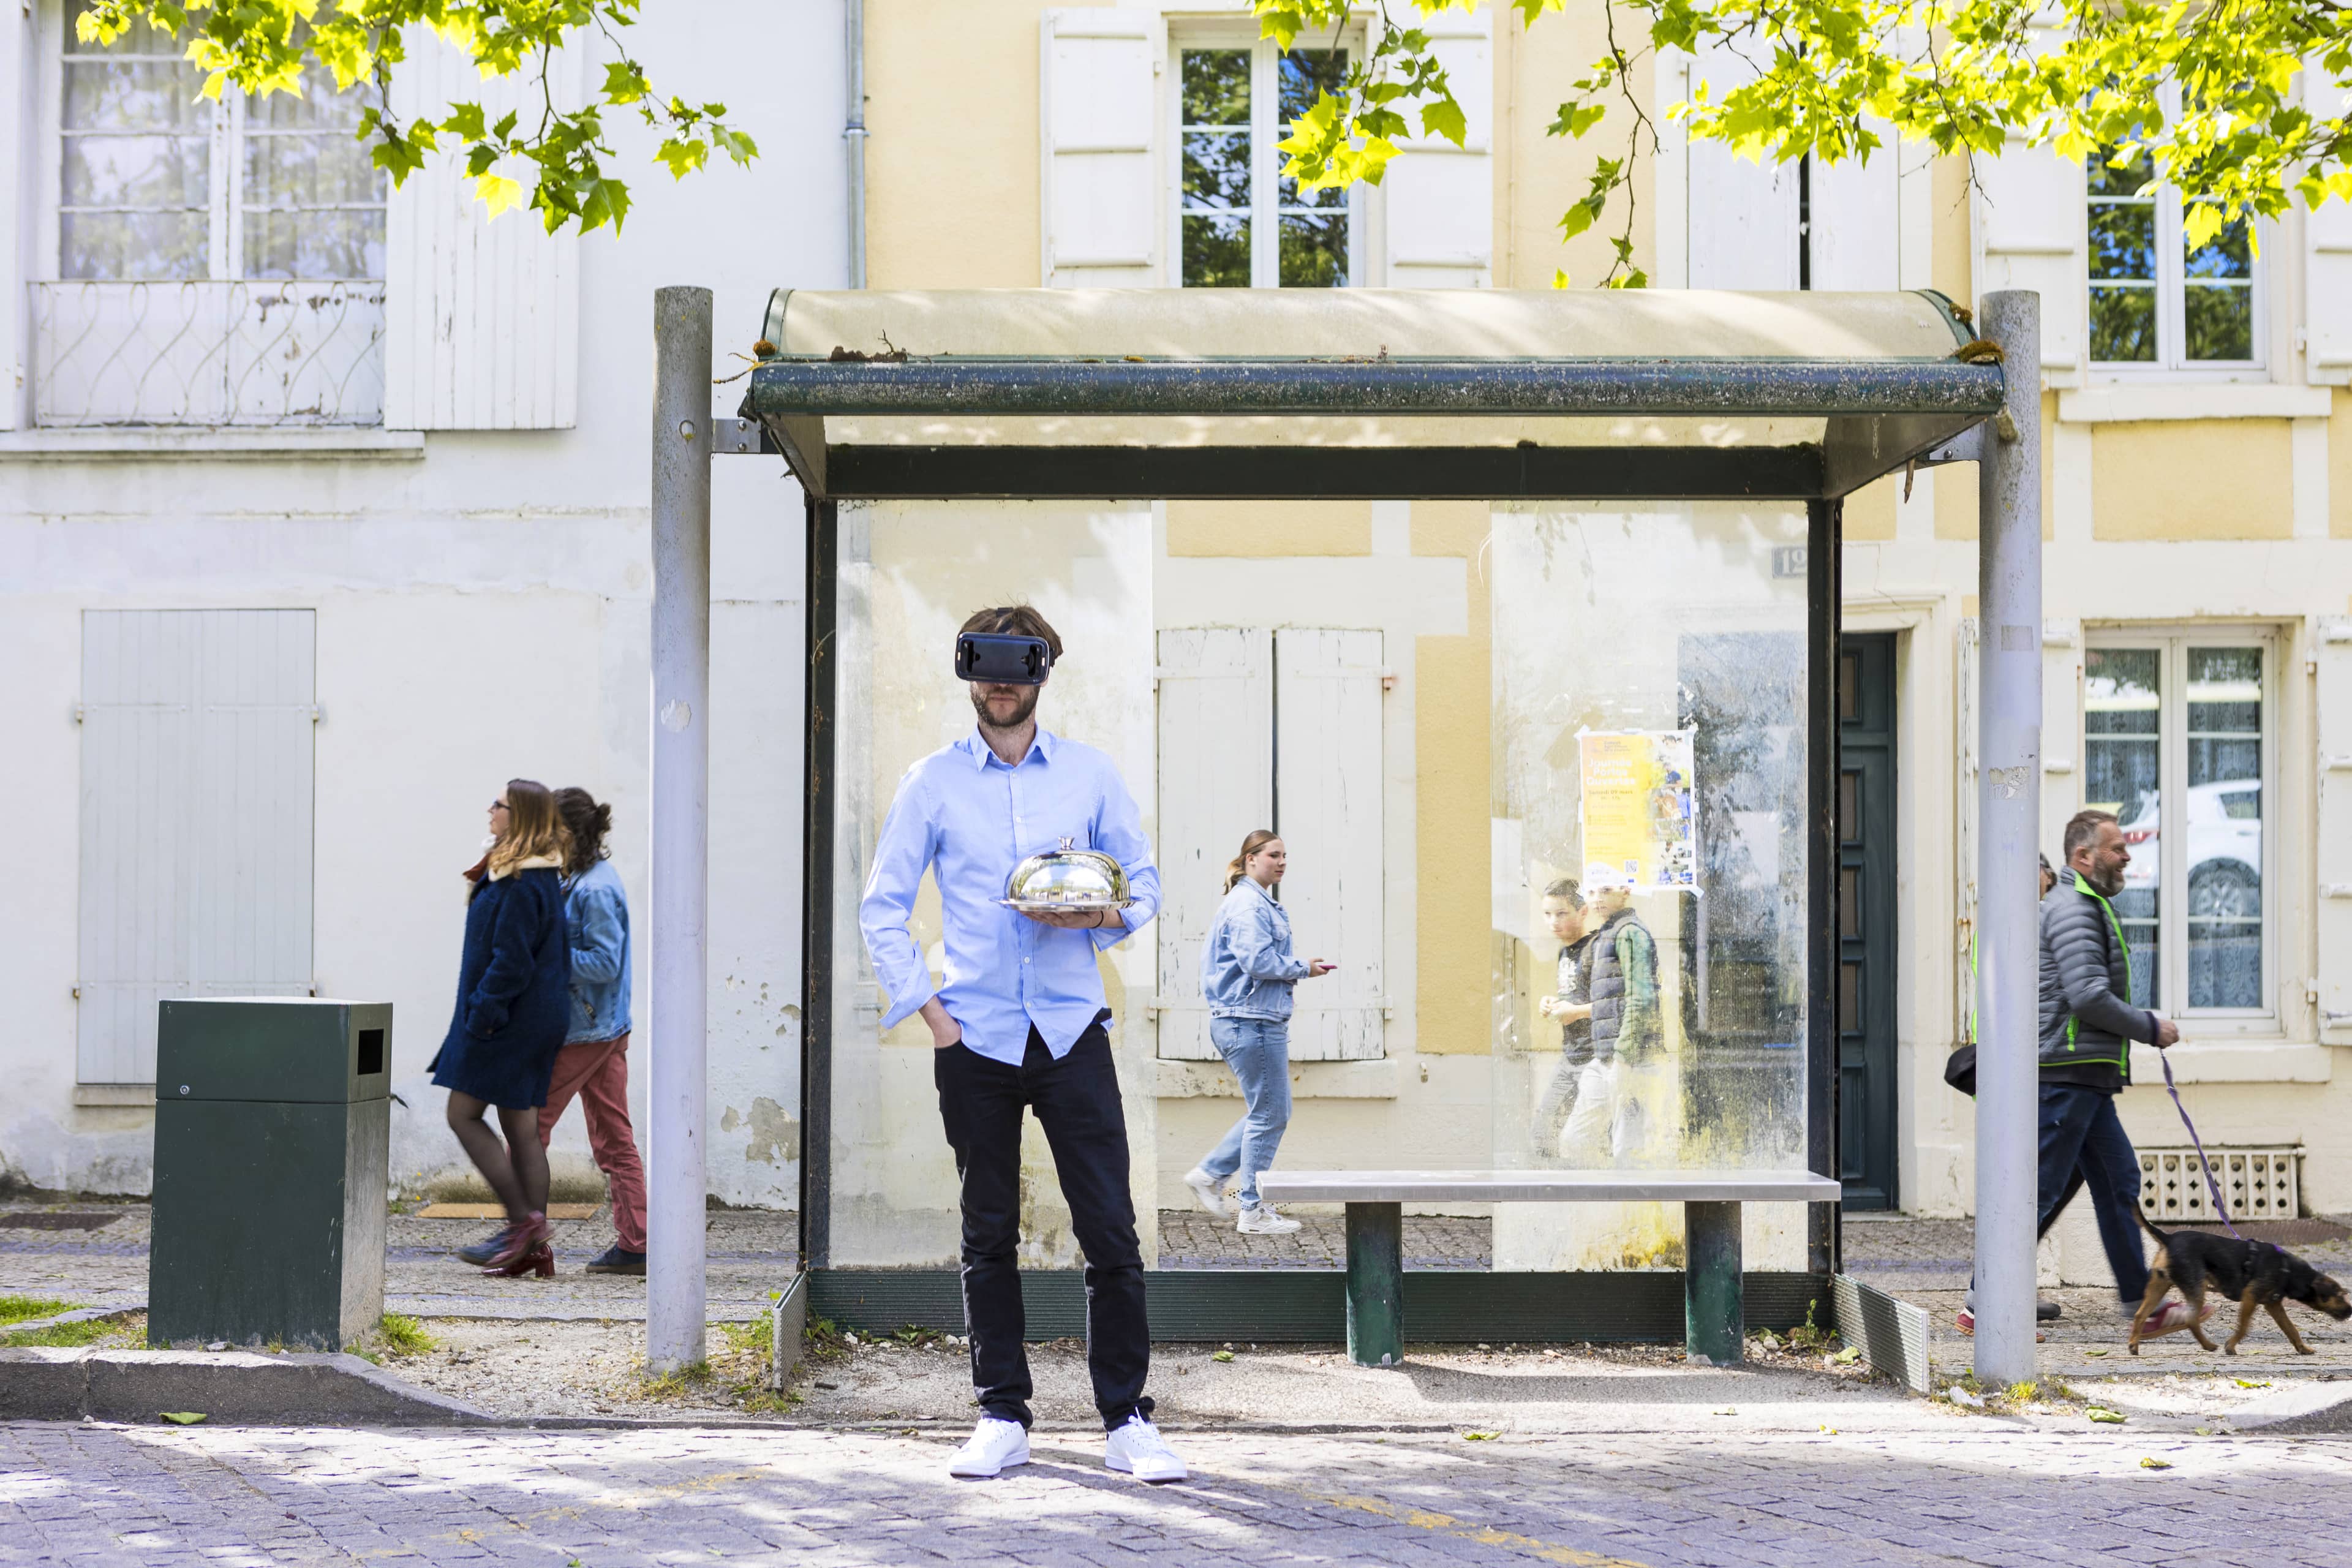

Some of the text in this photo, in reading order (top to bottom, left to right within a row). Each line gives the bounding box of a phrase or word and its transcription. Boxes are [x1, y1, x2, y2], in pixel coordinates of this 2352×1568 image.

[1588, 757, 1632, 768] Journée
[1593, 768, 1628, 777] Portes
[1587, 777, 1635, 785] Ouvertes
